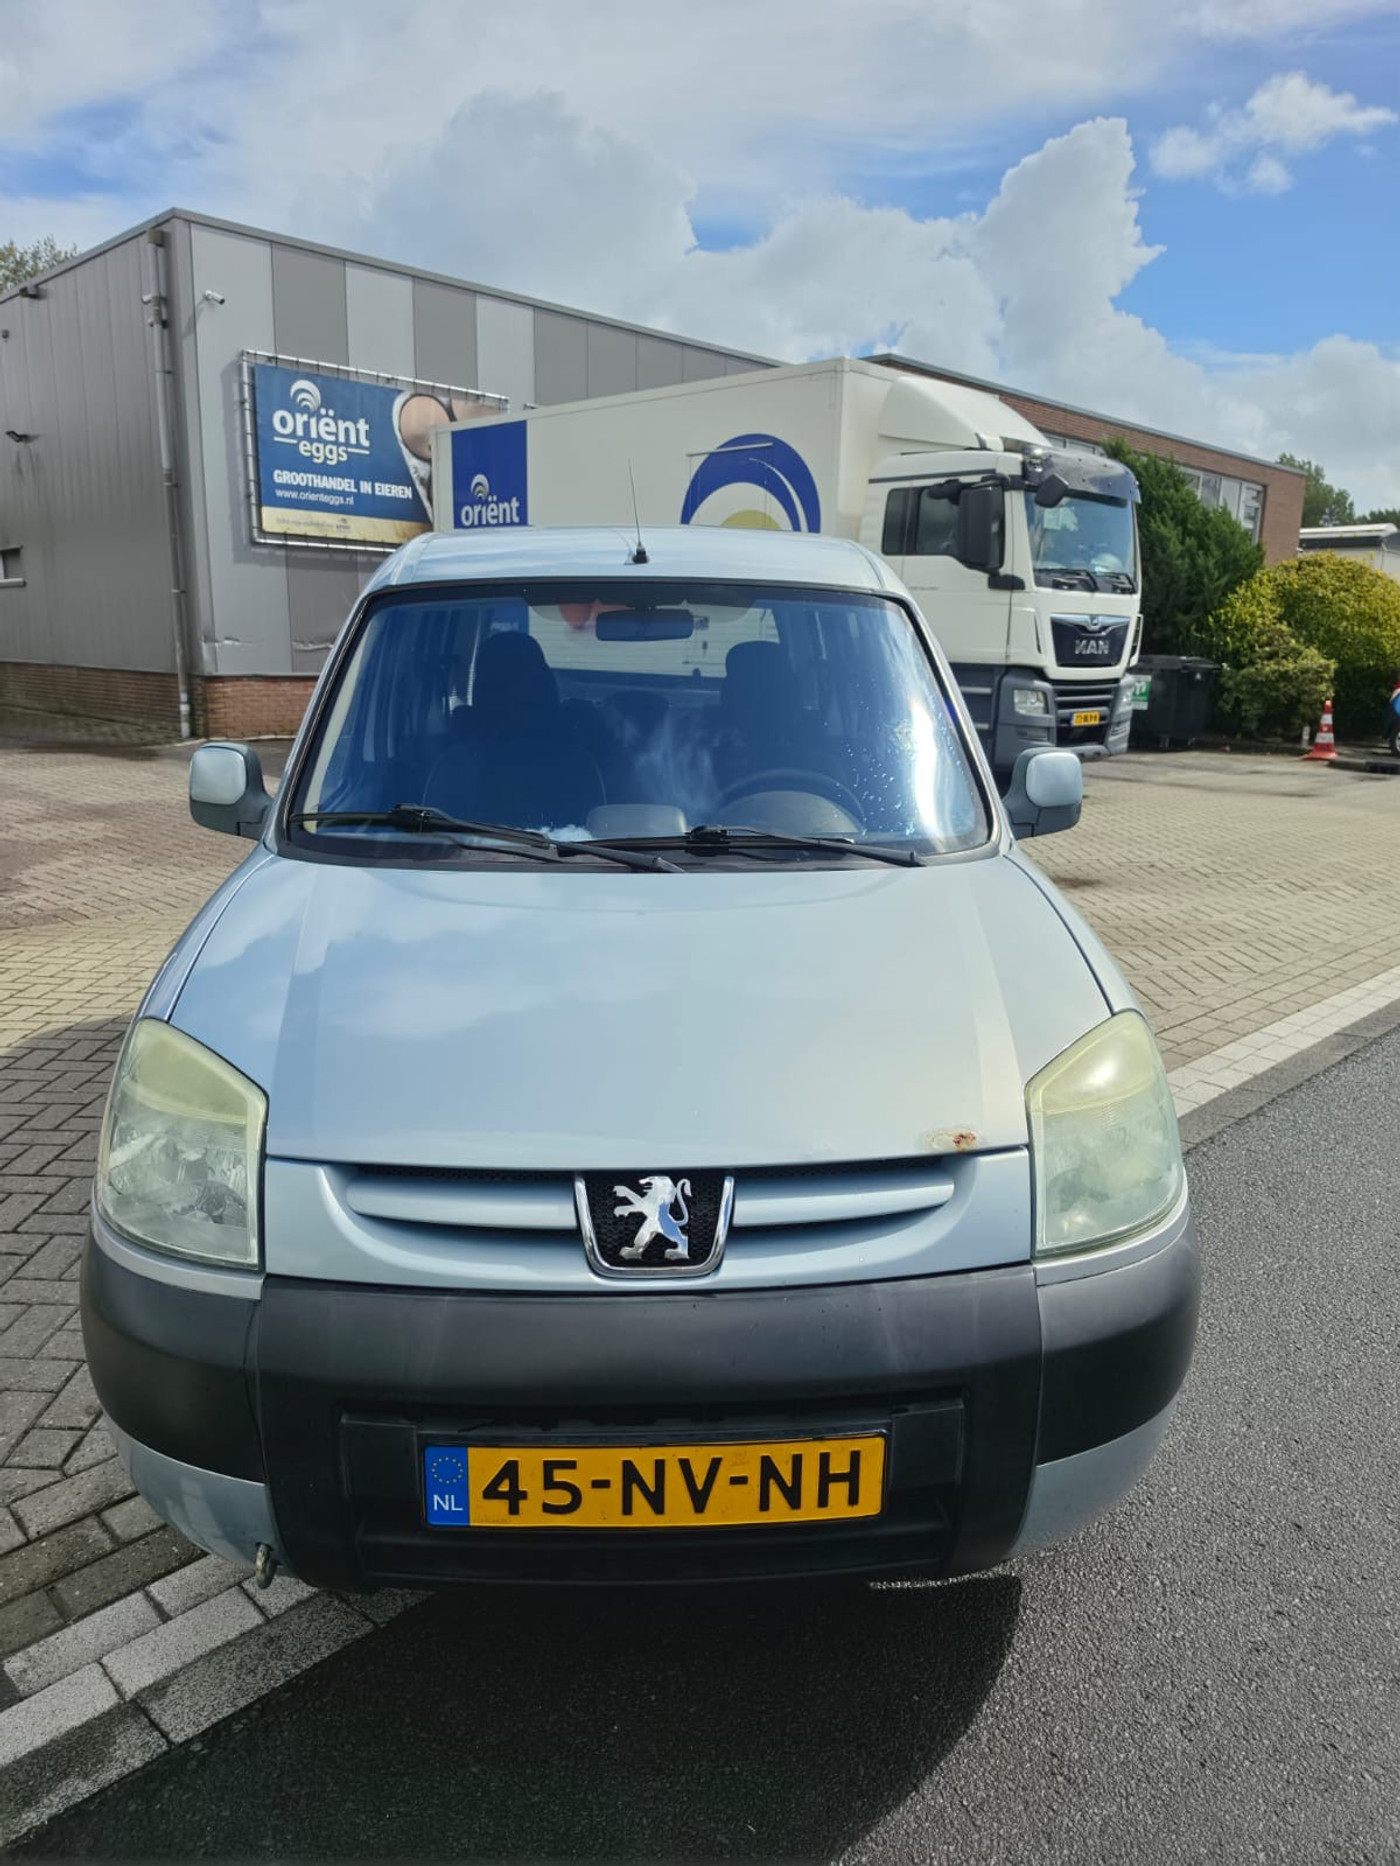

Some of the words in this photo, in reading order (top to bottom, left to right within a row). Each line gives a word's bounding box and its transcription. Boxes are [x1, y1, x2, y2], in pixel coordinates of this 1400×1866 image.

[298, 440, 349, 465] eggs
[273, 469, 358, 493] GROOTHANDEL
[360, 480, 372, 494] IN
[374, 482, 413, 499] EIEREN
[275, 488, 354, 506] www.orienteggs.nl
[1075, 640, 1109, 654] MAN
[433, 1494, 463, 1512] NL
[482, 1450, 861, 1516] 45-NV-NH
